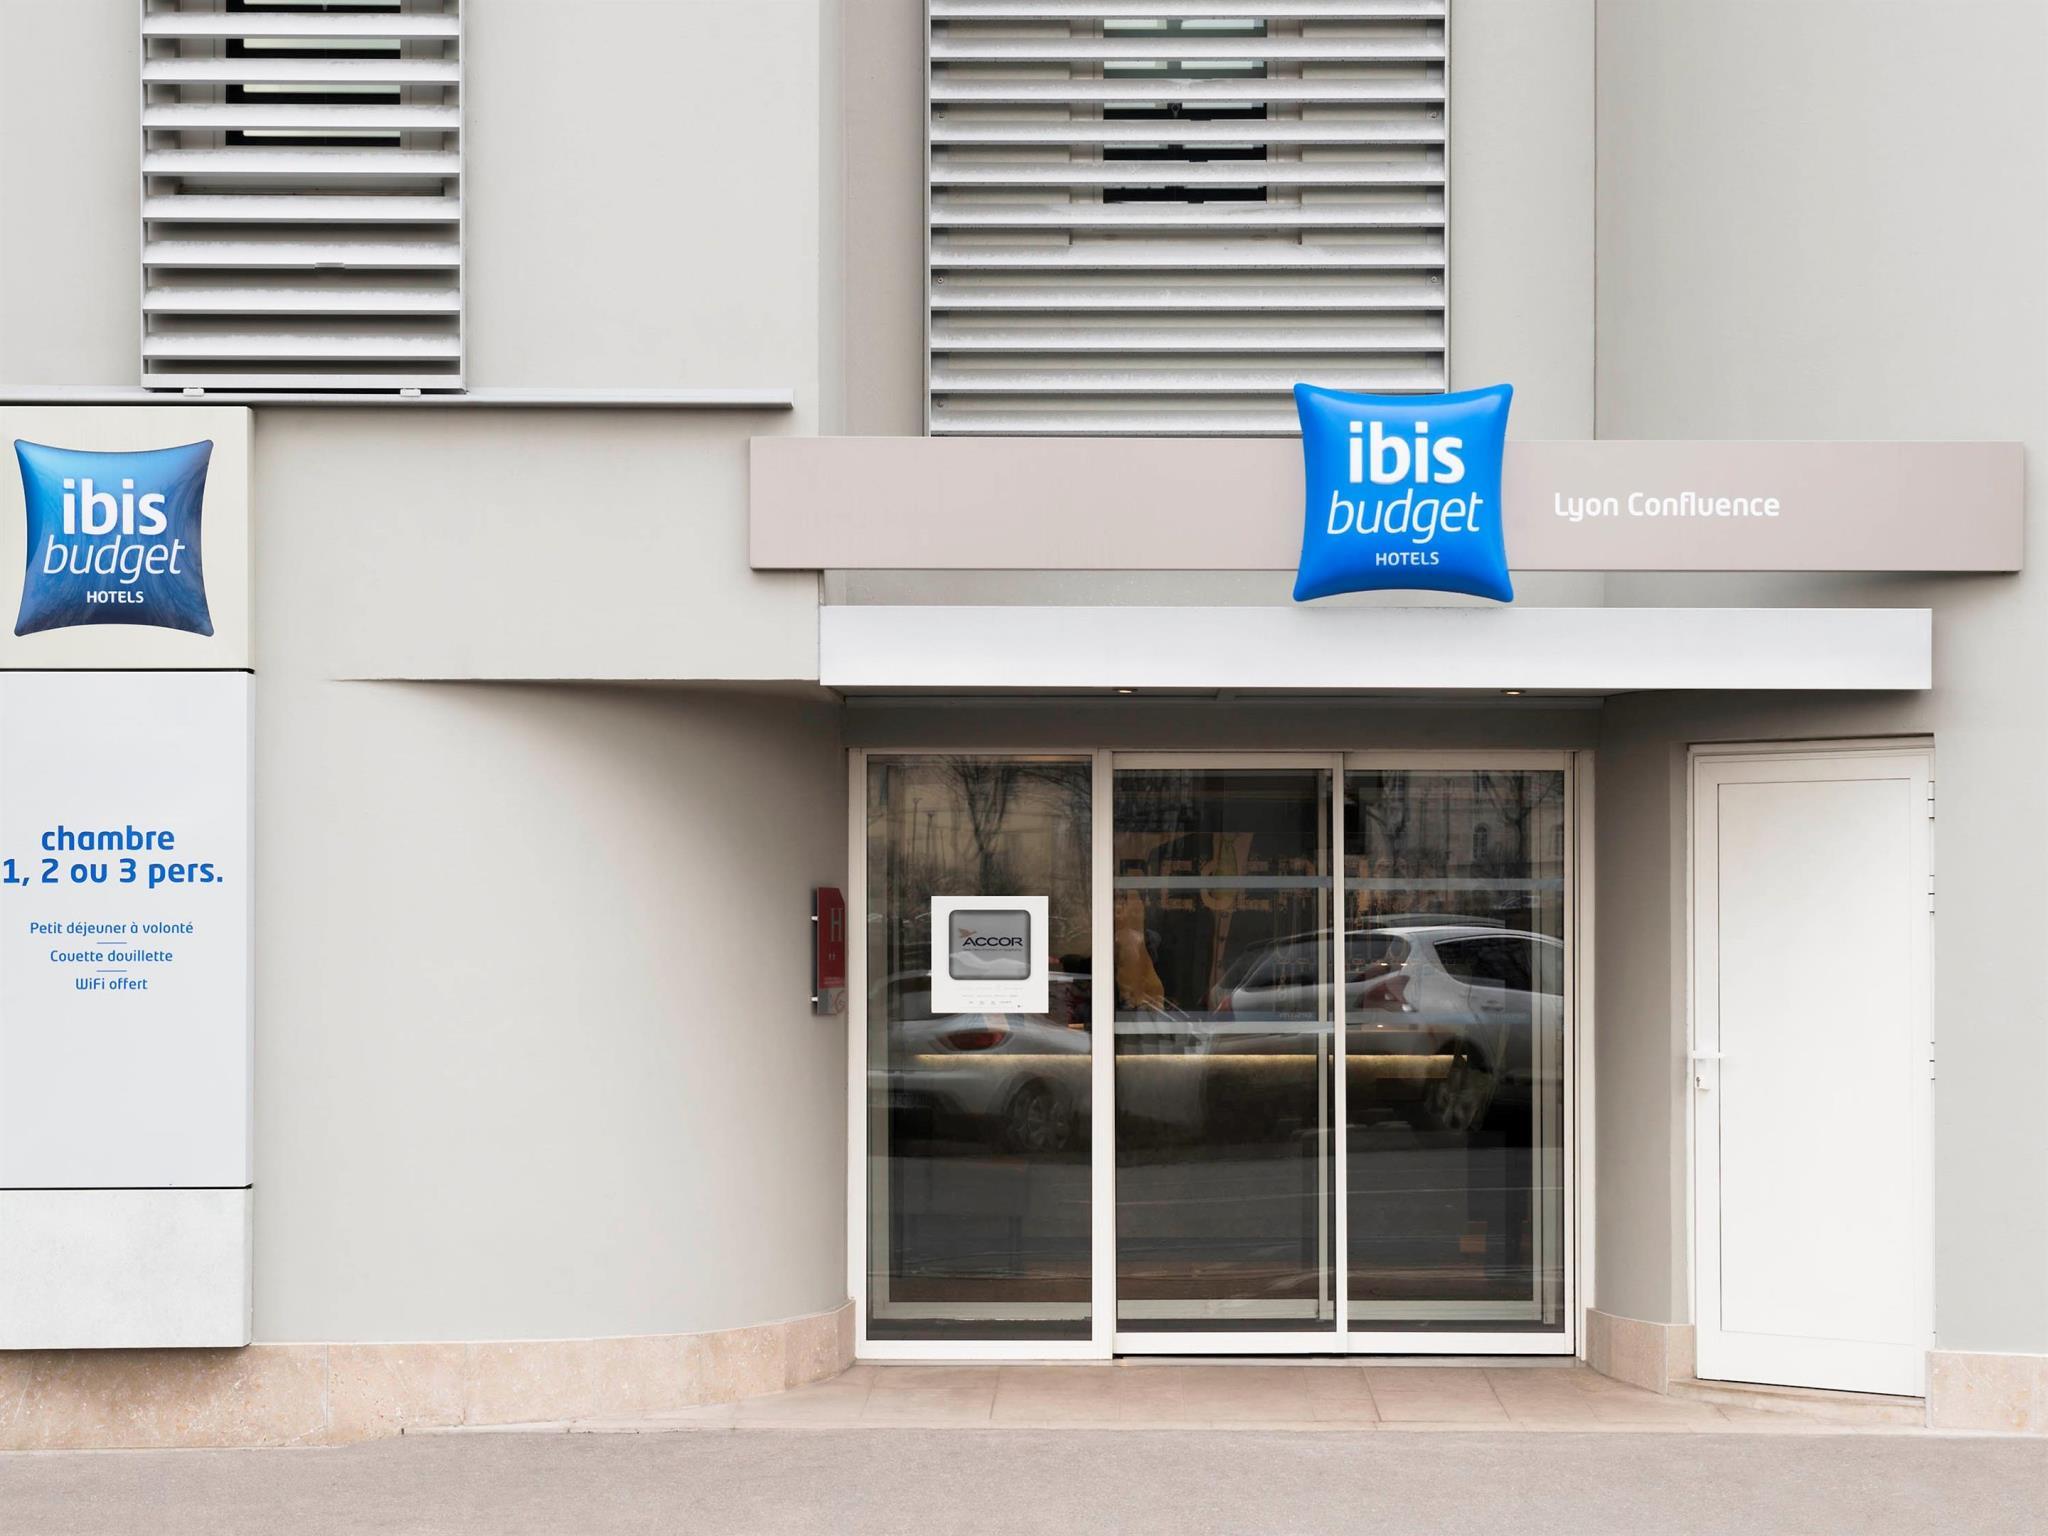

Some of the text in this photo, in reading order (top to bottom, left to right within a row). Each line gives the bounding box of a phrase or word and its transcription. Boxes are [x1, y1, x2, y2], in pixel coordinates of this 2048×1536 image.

[1349, 420, 1466, 485] ibis
[63, 478, 168, 536] ibis
[1327, 488, 1484, 544] budget
[1554, 491, 1781, 522] Lyon Confluence
[43, 534, 186, 585] budget
[1375, 551, 1440, 567] HOTELS
[86, 590, 144, 604] HOTELS
[41, 824, 175, 851] chambre
[3, 858, 224, 889] 1, 2 ou 3 pers.
[30, 921, 194, 937] Petit déjeuner à volonté
[962, 936, 1024, 947] ACCOR
[50, 949, 173, 963] Couette douillette
[75, 977, 148, 990] WiFi offert
